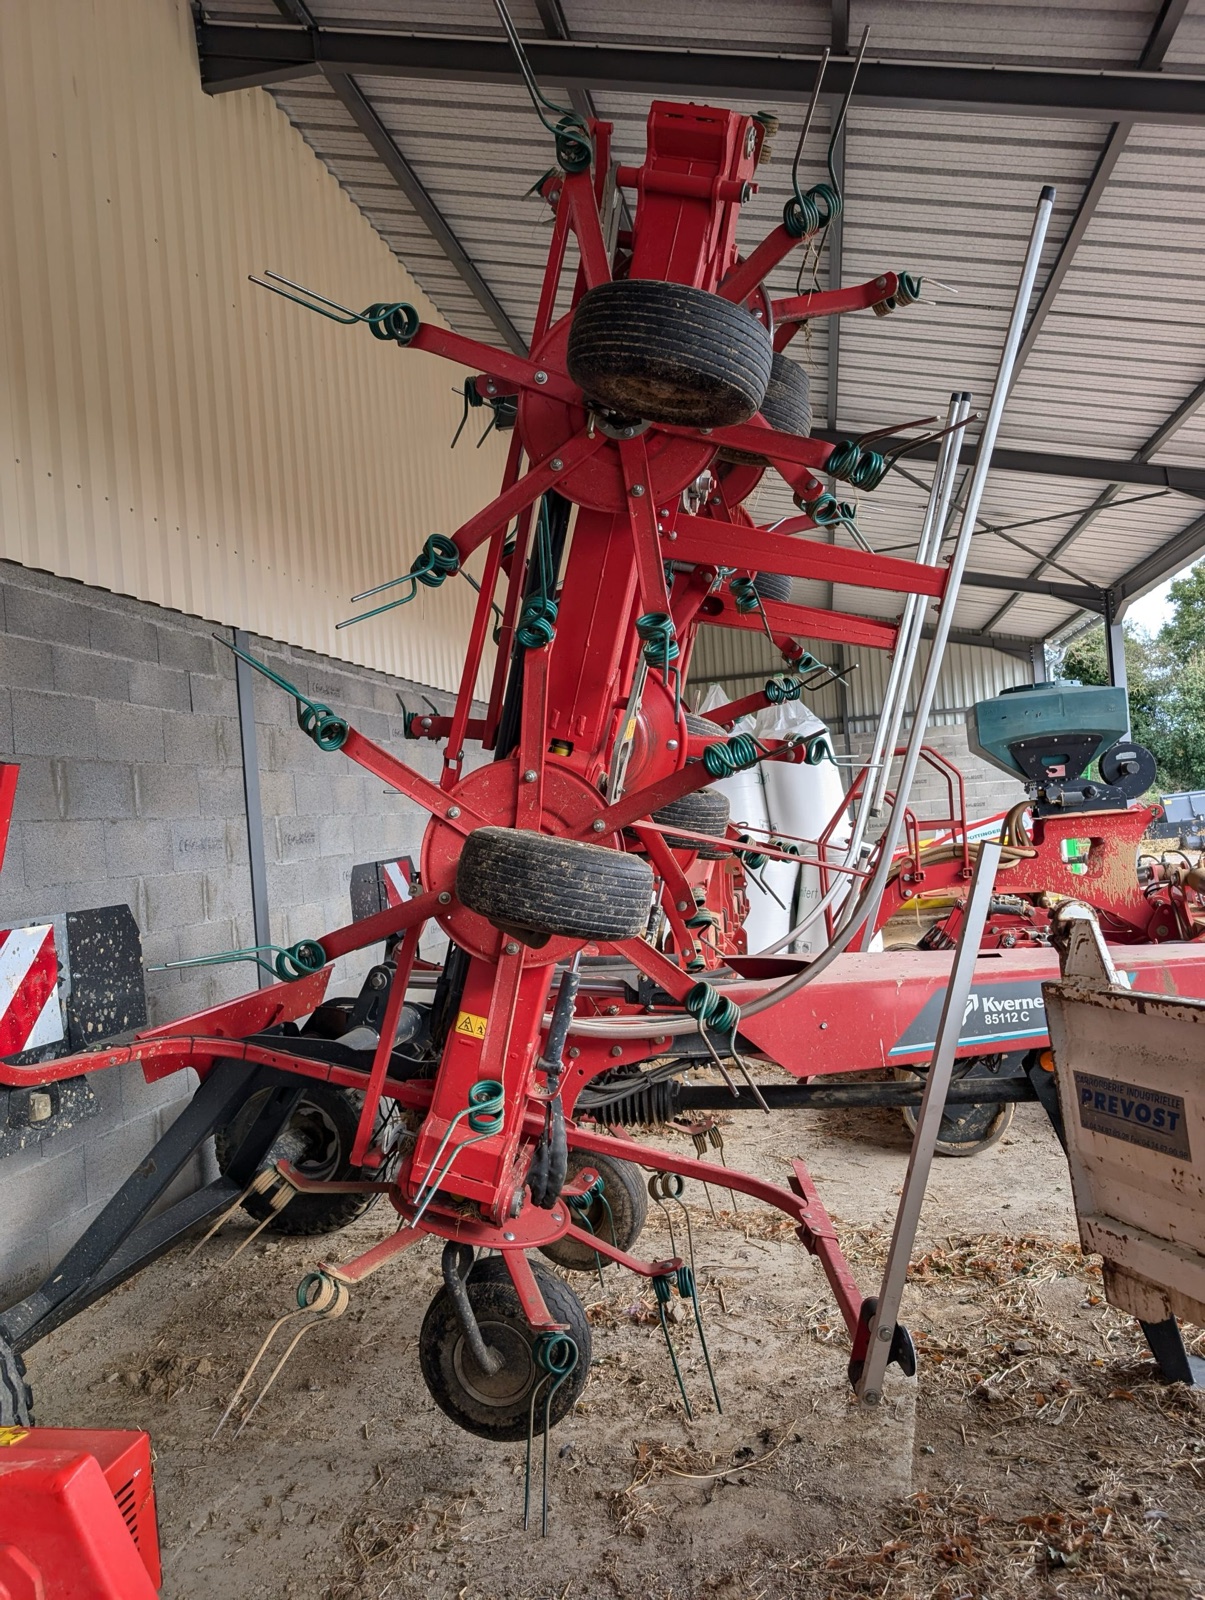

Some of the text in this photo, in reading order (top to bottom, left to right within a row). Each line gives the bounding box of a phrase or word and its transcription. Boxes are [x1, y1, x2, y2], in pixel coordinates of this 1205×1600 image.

[984, 1011, 1030, 1025] 85112 C
[1126, 1087, 1181, 1109] INDUSTRIELLE
[1081, 1088, 1180, 1131] PREVOST
